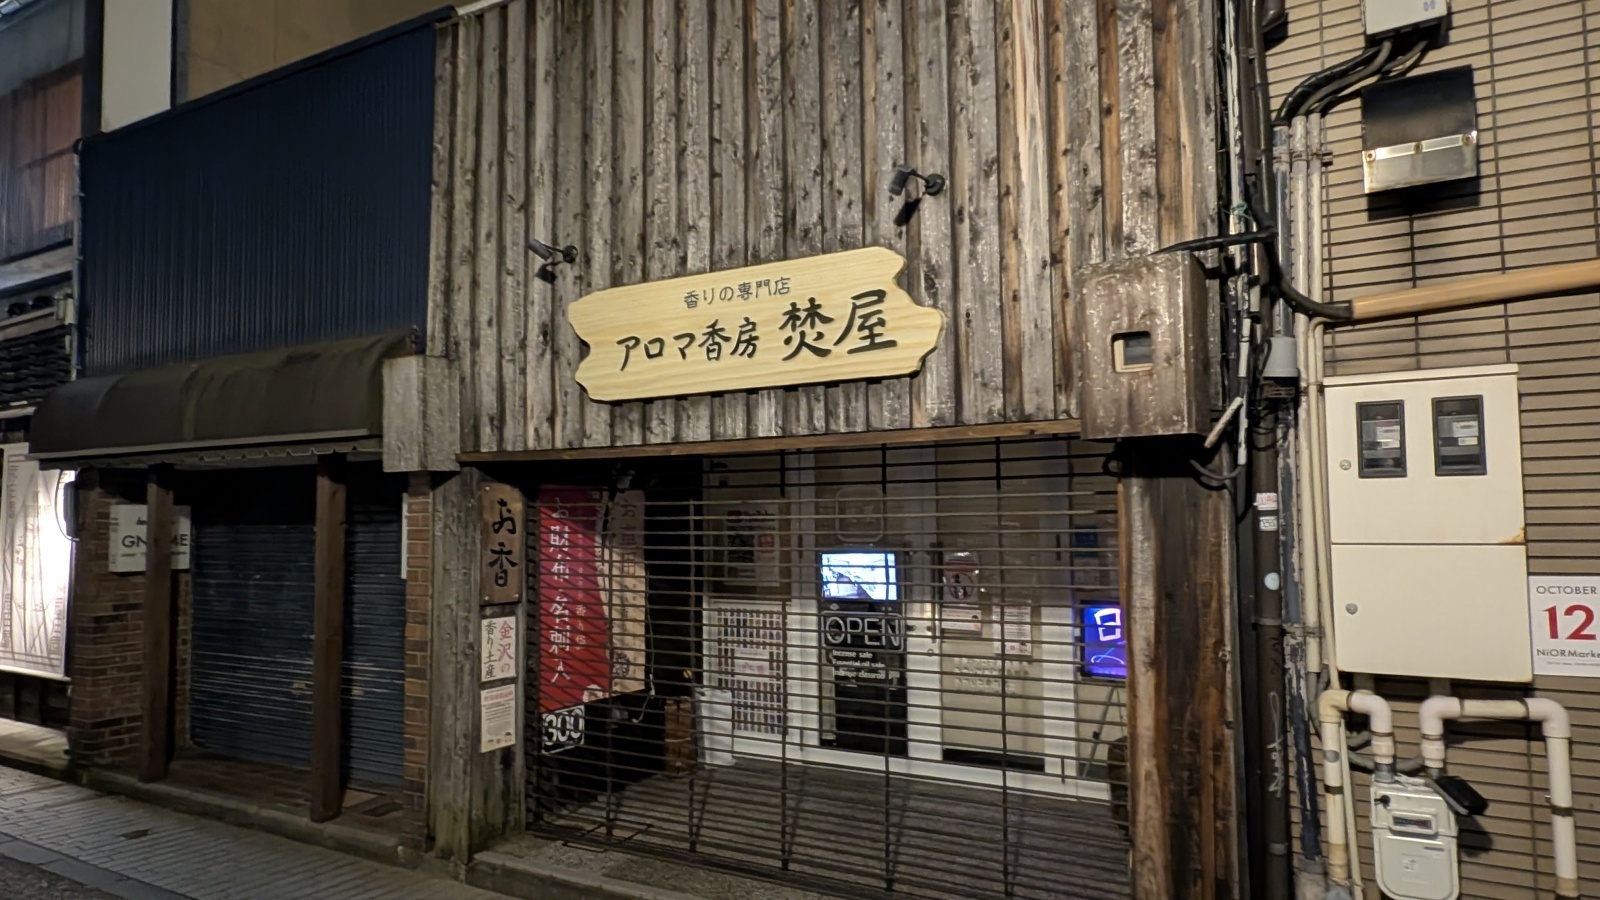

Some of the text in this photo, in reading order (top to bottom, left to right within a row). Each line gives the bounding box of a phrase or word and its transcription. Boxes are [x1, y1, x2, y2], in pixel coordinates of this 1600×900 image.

[683, 276, 792, 309] 香りの専門店
[616, 288, 898, 372] アロマ香房 焚屋
[488, 498, 519, 588] お香
[1536, 585, 1597, 595] OCTOBER
[826, 617, 900, 646] OPEN
[1542, 604, 1597, 641] 12
[483, 619, 498, 680] 香り土産
[498, 620, 514, 675] 金沢の
